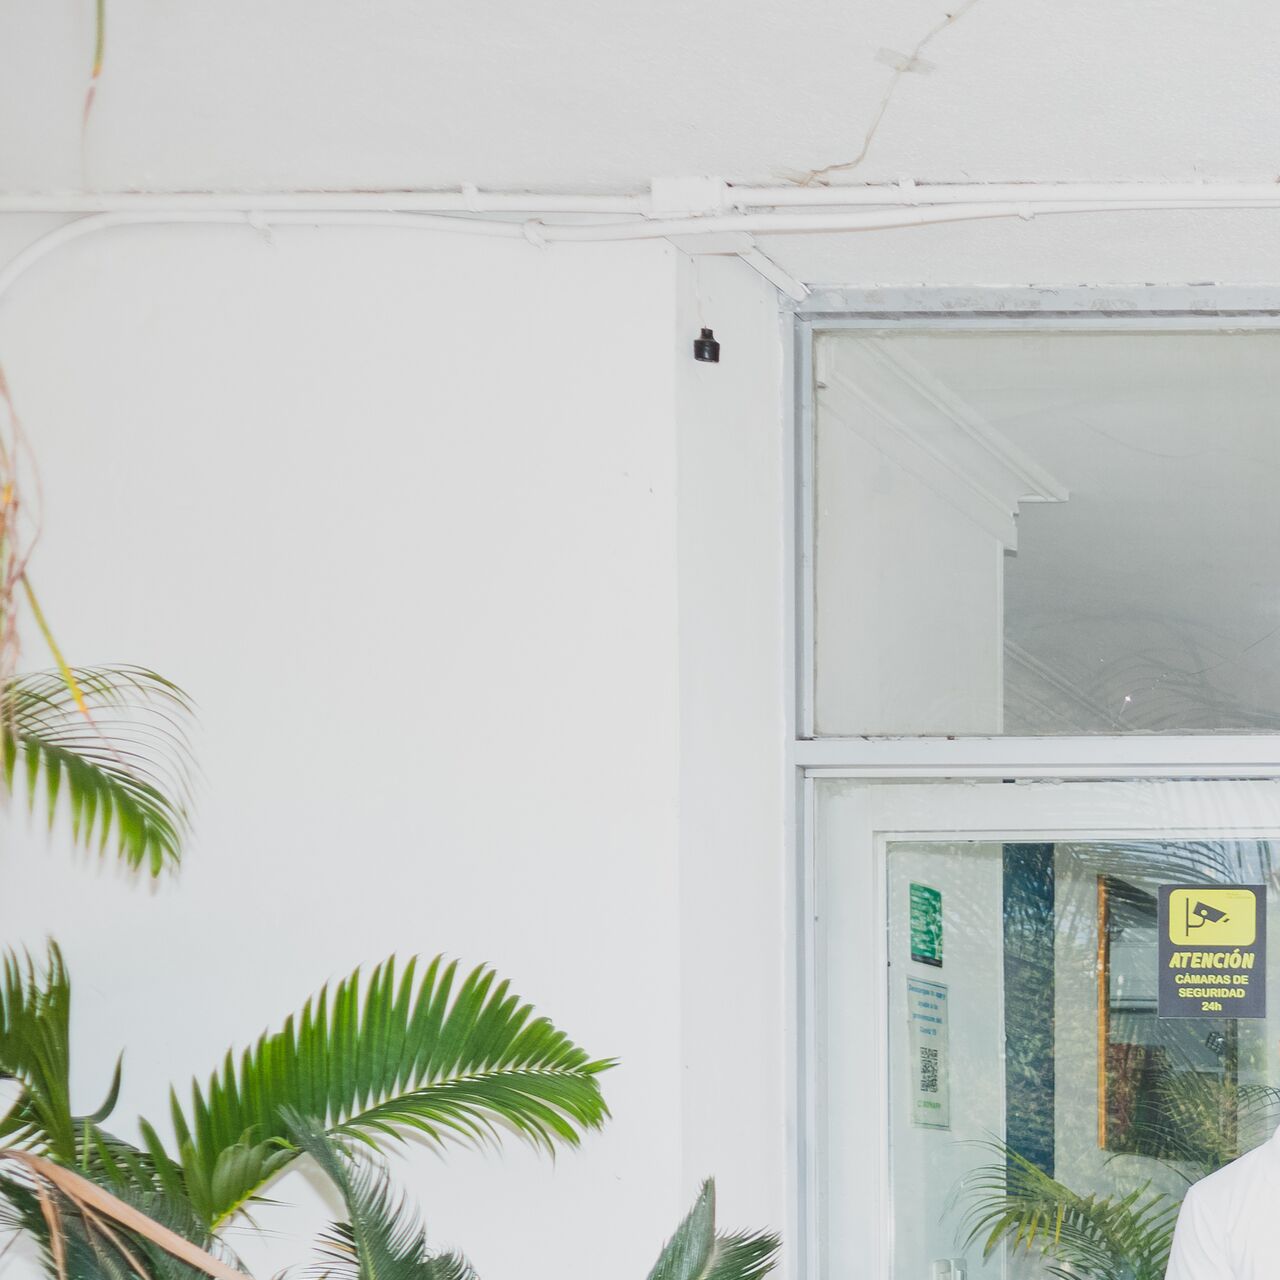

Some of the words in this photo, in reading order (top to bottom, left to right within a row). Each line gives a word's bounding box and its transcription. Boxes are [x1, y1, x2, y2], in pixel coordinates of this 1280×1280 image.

[1169, 948, 1255, 969] ATENCIÓN
[1175, 973, 1231, 985] CÁMARAS
[1233, 975, 1249, 984] DE
[1178, 988, 1245, 998] SEGURIDAD
[1201, 1002, 1222, 1011] 24h
